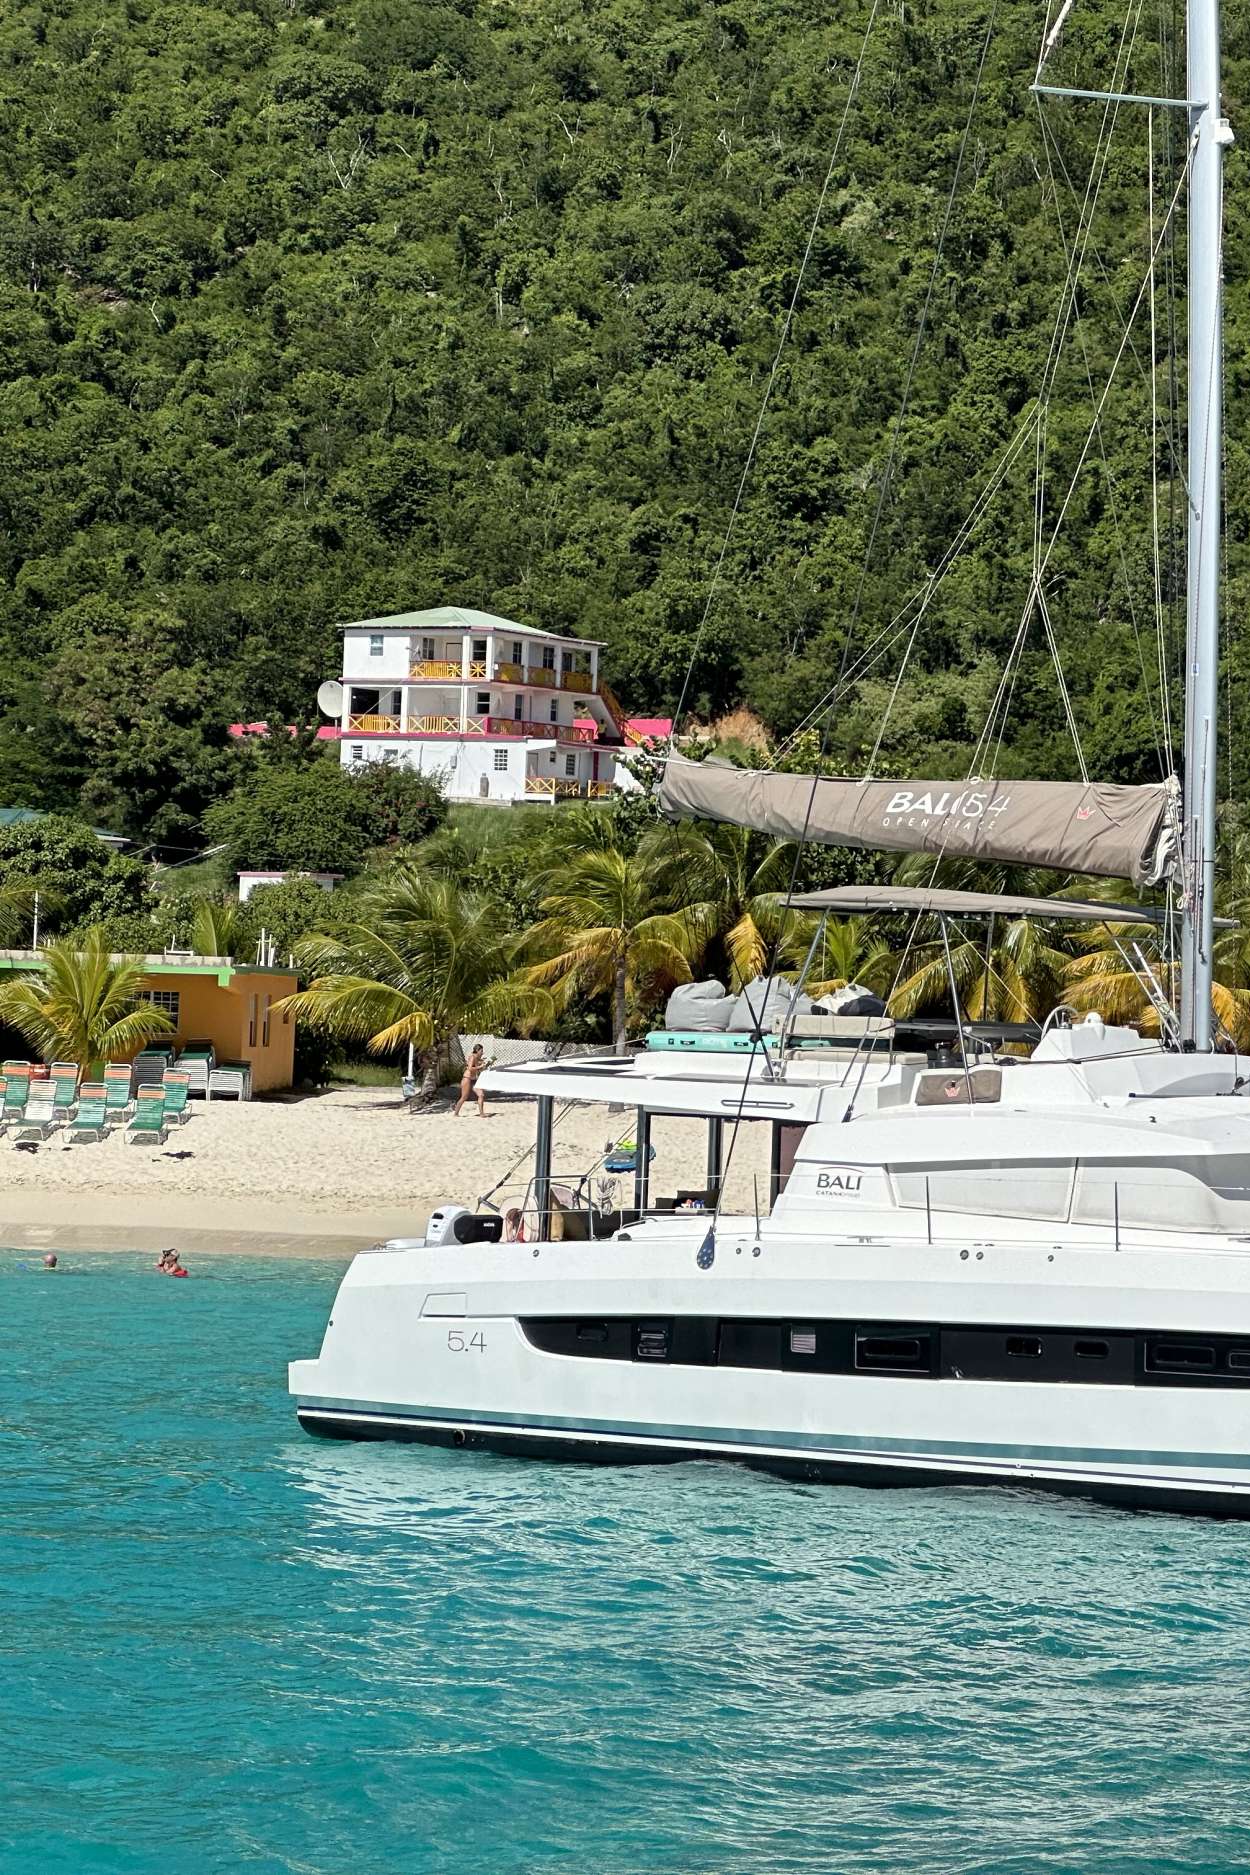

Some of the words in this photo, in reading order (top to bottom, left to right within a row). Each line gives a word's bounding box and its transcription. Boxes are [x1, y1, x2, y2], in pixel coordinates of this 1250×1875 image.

[886, 791, 968, 815] BALI
[882, 817, 930, 828] OPEN
[817, 1173, 863, 1190] BALI
[447, 1330, 488, 1353] 5.4
